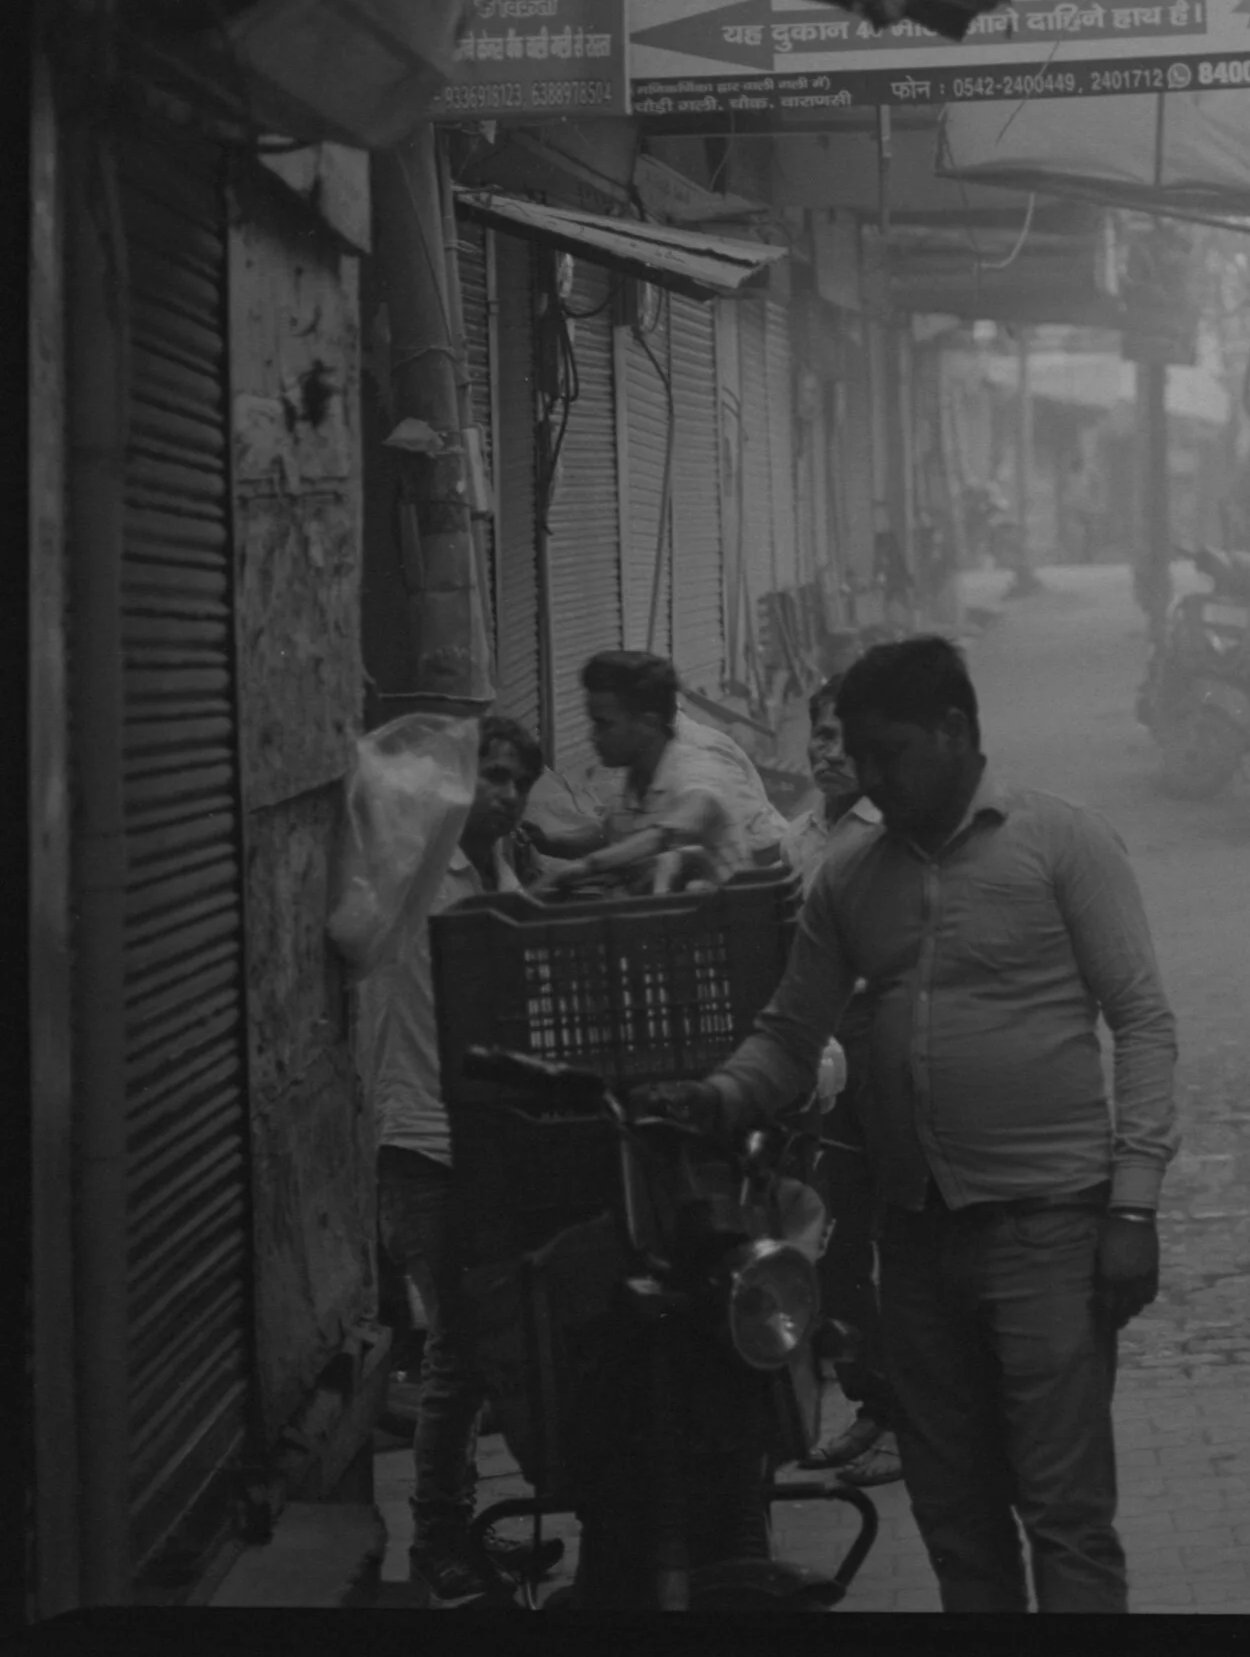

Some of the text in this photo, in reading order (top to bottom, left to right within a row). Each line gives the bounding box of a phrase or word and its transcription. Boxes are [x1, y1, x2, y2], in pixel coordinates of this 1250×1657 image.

[722, 23, 763, 47] यह
[773, 19, 850, 51] दुकान
[1025, 1, 1106, 34] दाहिने
[1112, 6, 1161, 29] हाथ
[780, 89, 853, 108] वाराणसी
[890, 75, 932, 100] फोन
[1091, 68, 1164, 91] 2401712
